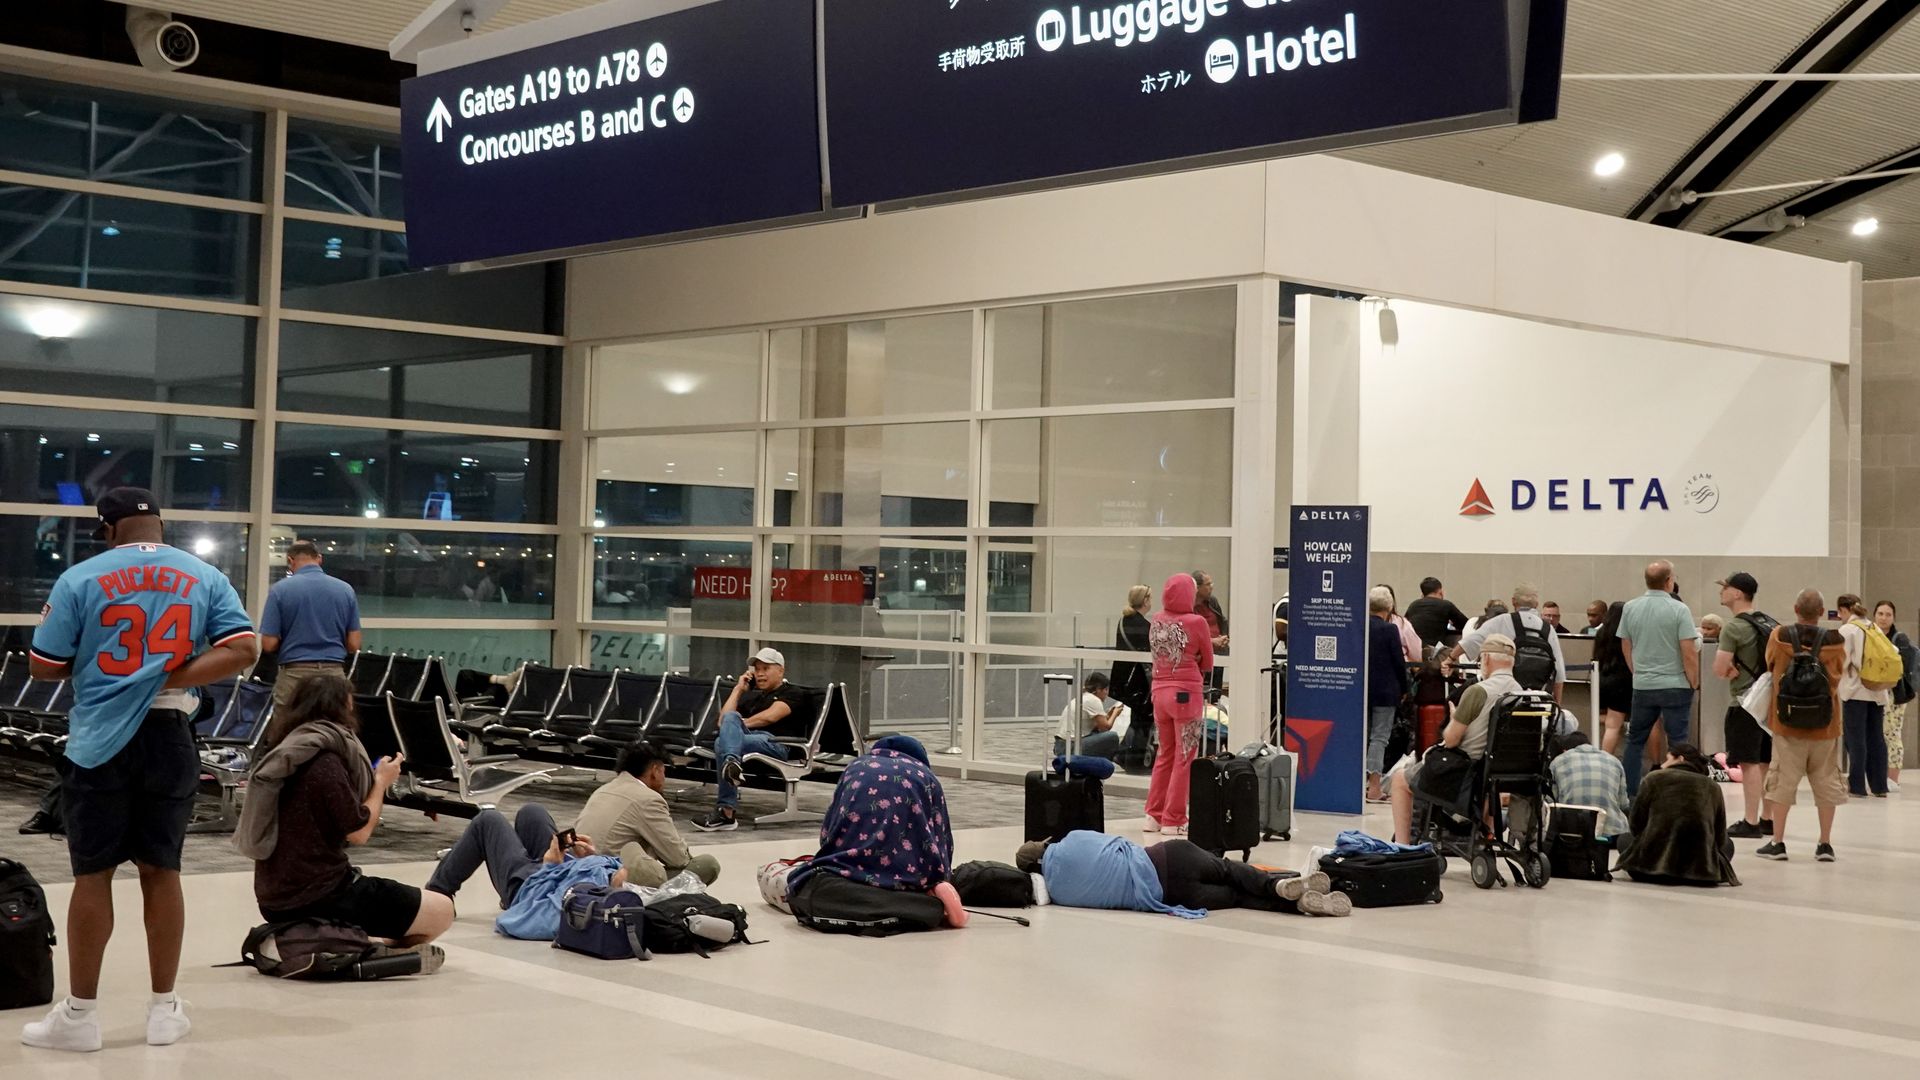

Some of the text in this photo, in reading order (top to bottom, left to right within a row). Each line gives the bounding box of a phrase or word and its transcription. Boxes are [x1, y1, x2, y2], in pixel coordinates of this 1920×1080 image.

[938, 35, 1026, 72] 手荷物受取所
[1246, 13, 1357, 77] Hotel
[459, 49, 641, 119] Gates A19 to A78
[1141, 70, 1191, 94] ホテル
[460, 95, 668, 166] Concourses B and C
[1511, 477, 1669, 511] DELTA
[1311, 511, 1350, 520] DELTA
[1304, 542, 1352, 552] HOW CAN
[1306, 553, 1352, 563] WE HELP?
[97, 563, 200, 600] PUCKETT
[700, 575, 787, 597] NEED HP?
[97, 604, 194, 676] 34
